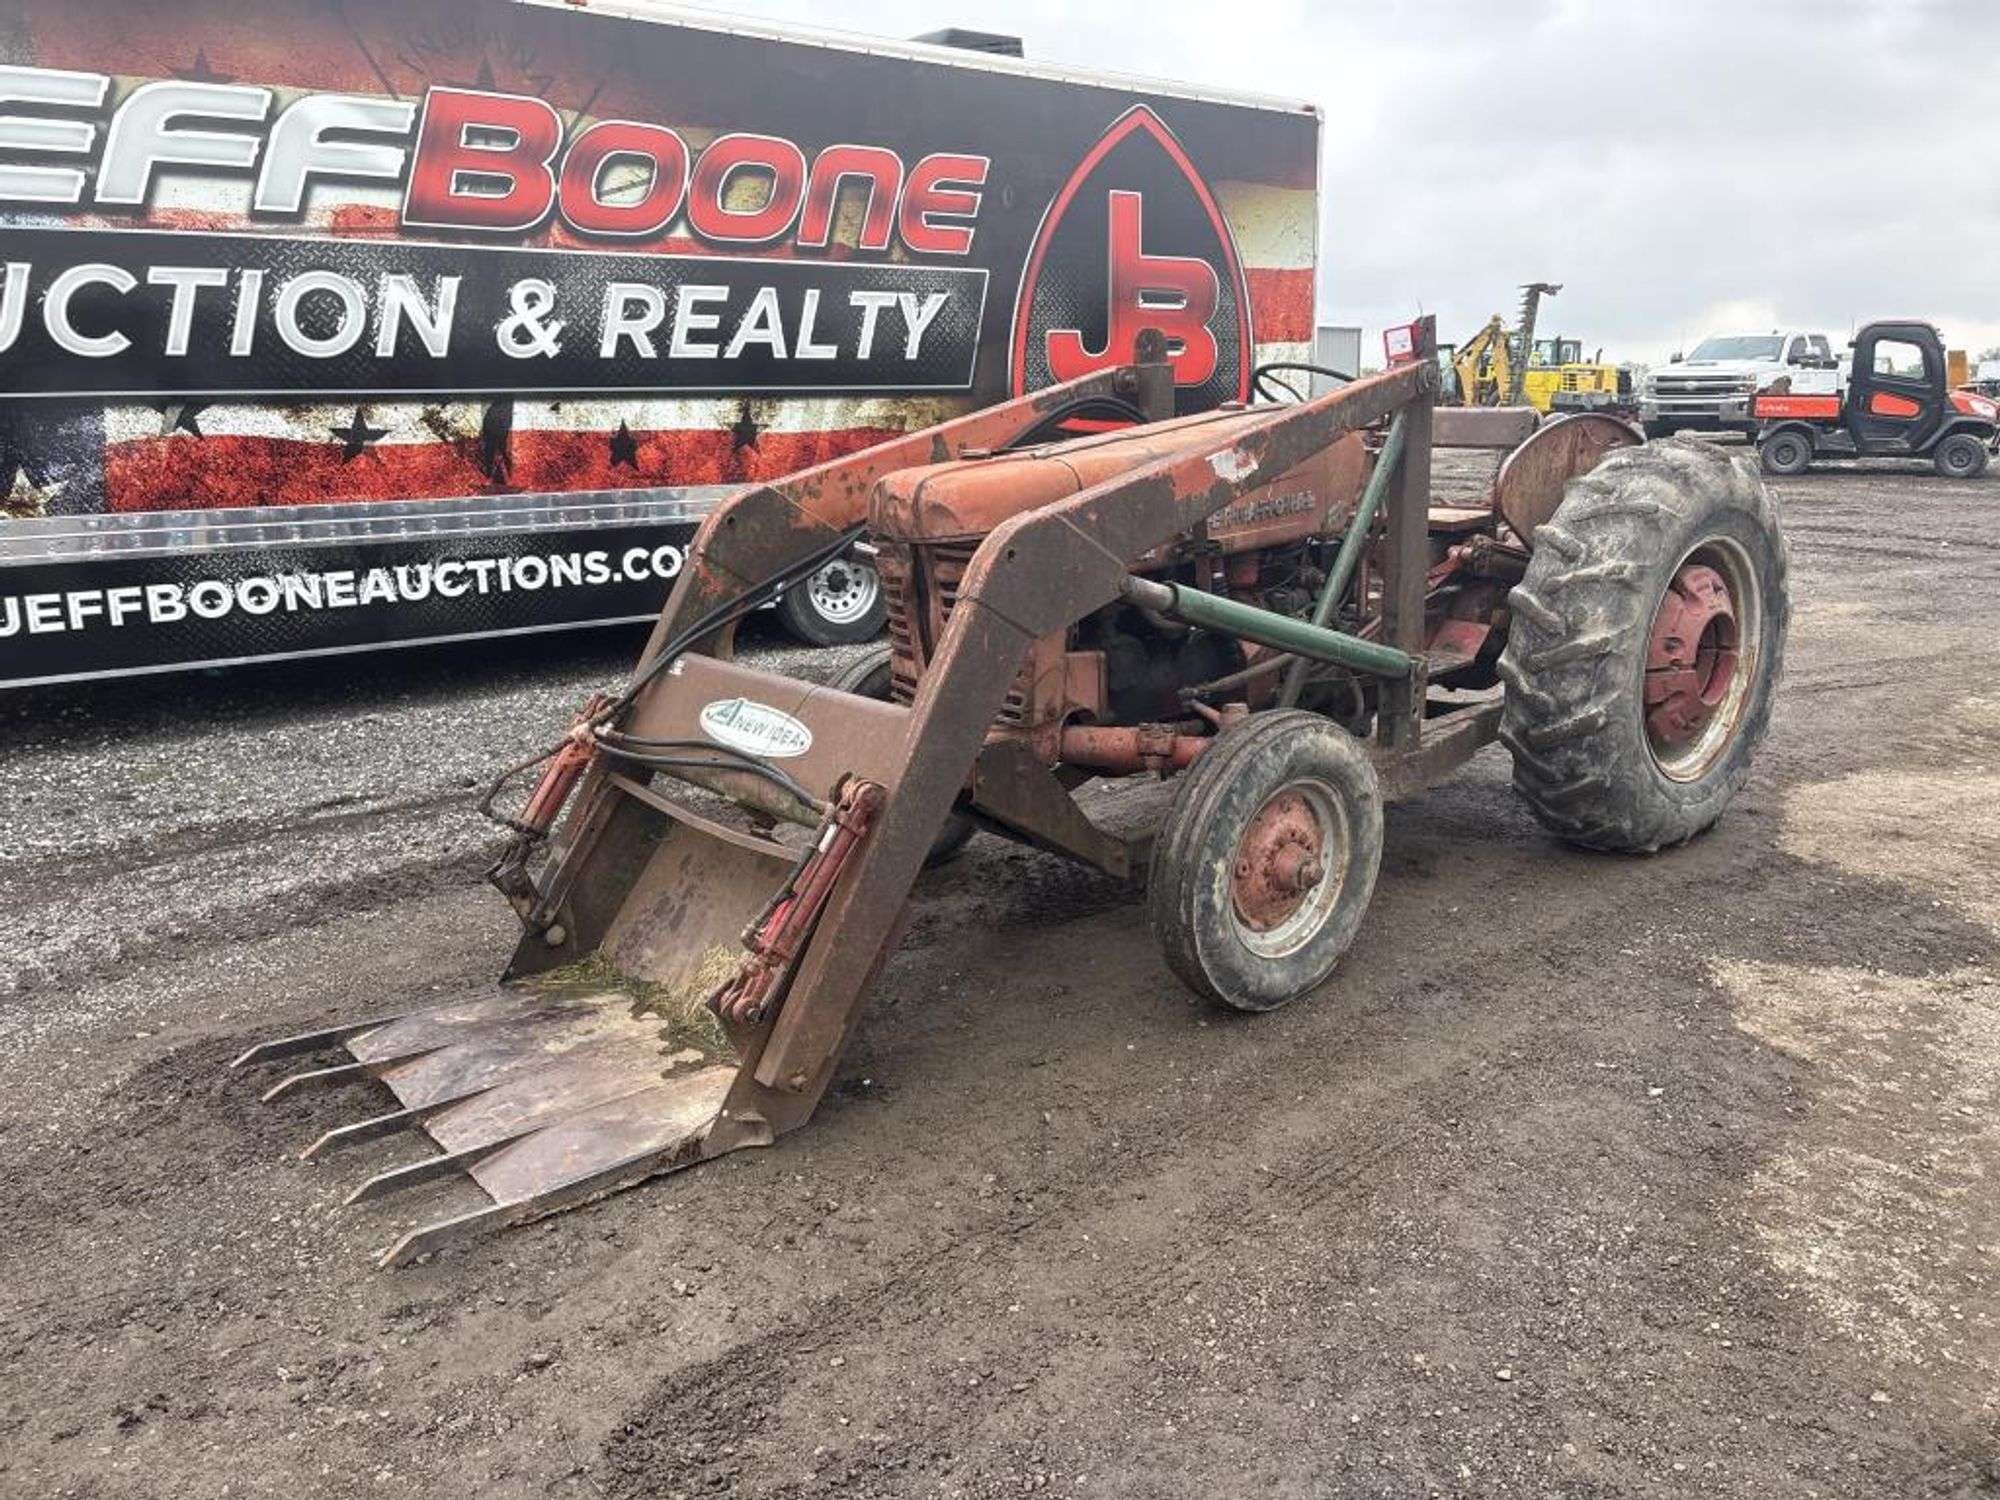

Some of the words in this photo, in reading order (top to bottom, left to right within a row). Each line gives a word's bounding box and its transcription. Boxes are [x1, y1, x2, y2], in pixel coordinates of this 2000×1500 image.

[496, 278, 563, 359] &
[600, 281, 951, 360] REALTY
[0, 543, 691, 637] JEFFBOONEAUCTIONS.CO
